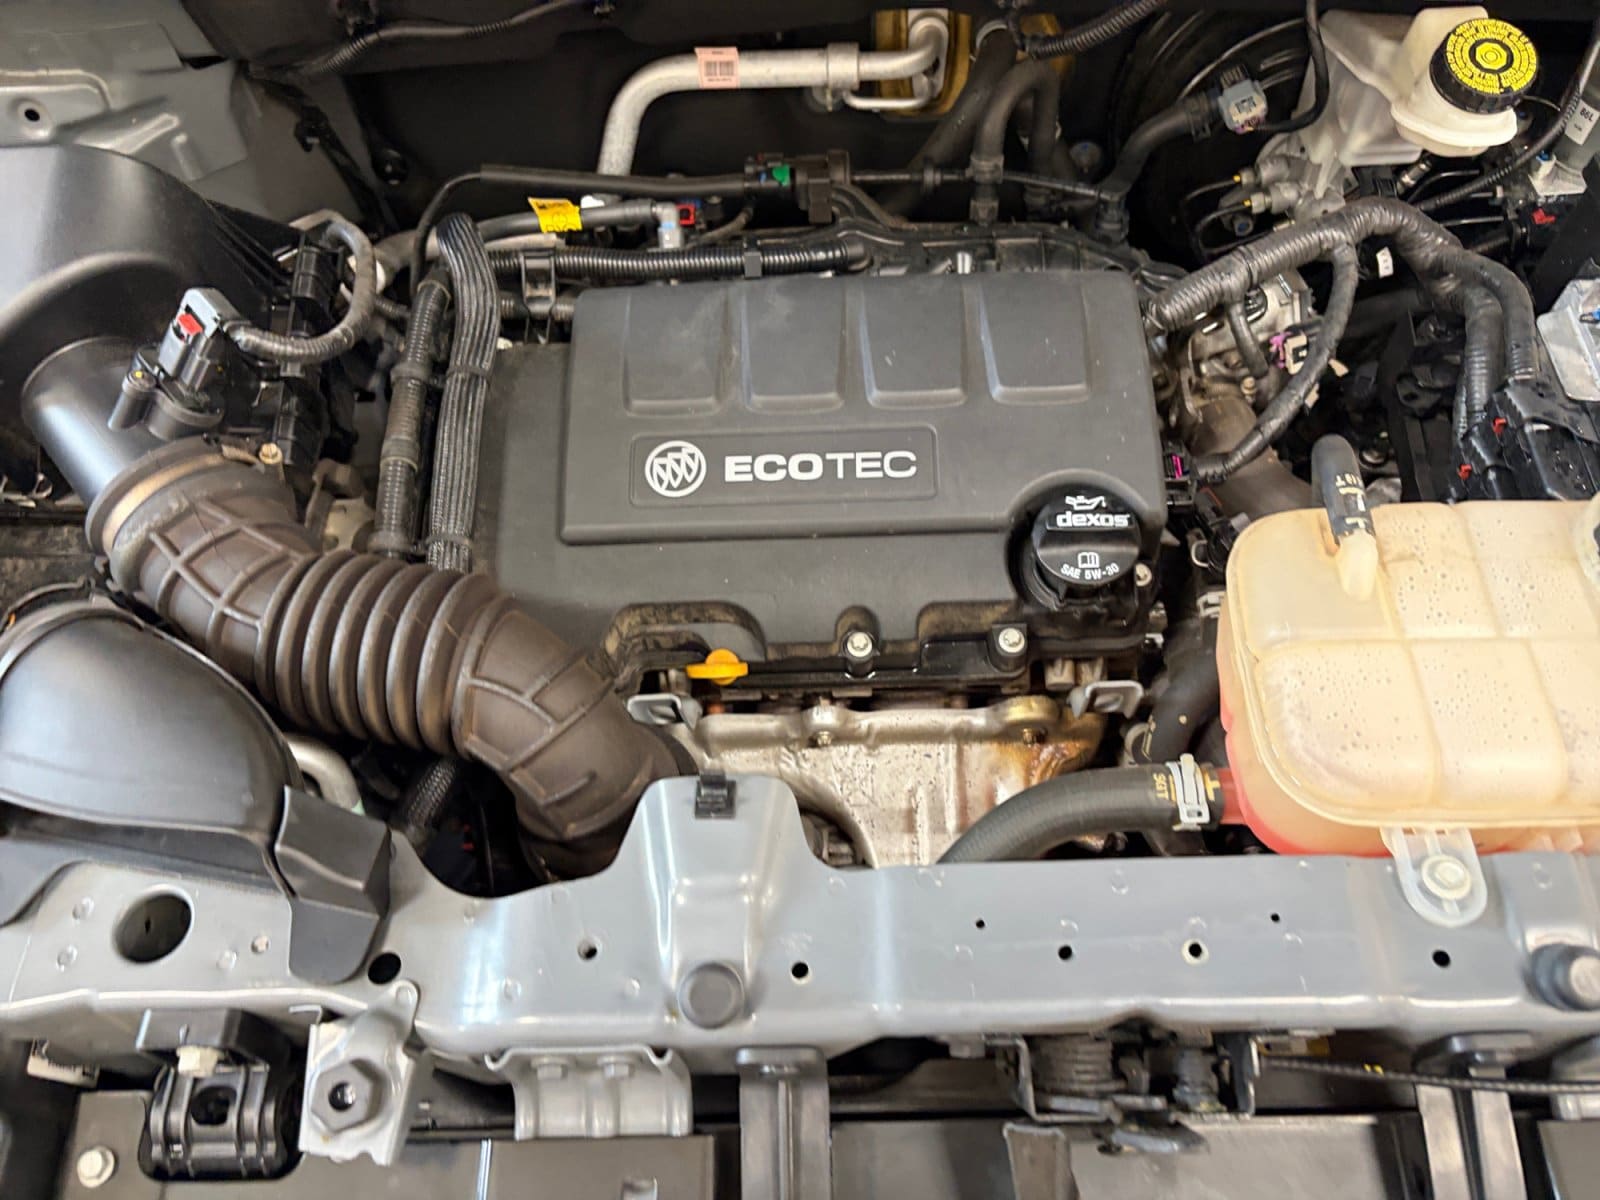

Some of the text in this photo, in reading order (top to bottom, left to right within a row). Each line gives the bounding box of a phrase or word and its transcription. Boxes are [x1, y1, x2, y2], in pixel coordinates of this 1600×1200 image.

[725, 450, 917, 482] ECOTEC
[1056, 510, 1130, 528] dexos
[1060, 562, 1120, 580] SAE 5W-30
